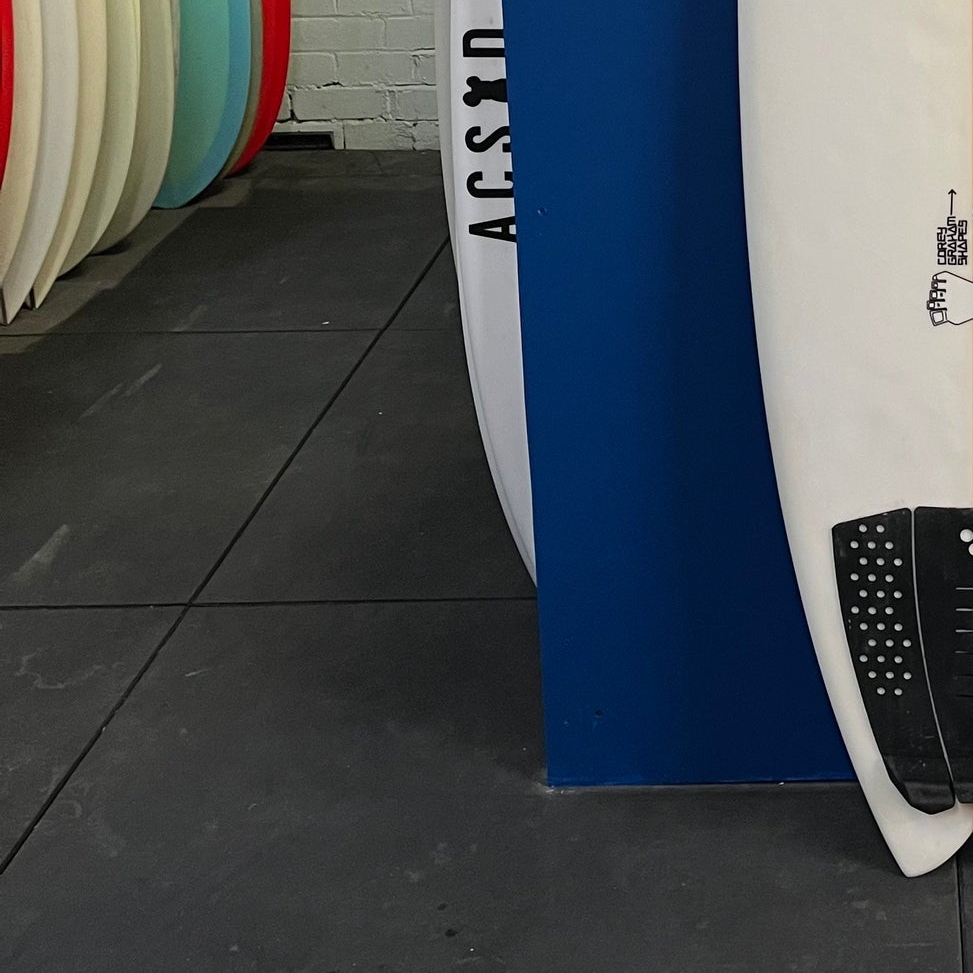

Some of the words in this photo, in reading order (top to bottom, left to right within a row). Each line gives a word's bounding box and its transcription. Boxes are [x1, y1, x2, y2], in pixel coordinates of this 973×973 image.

[937, 227, 947, 265] COREY
[947, 216, 958, 265] GRAHAM
[958, 220, 968, 265] SHAPES
